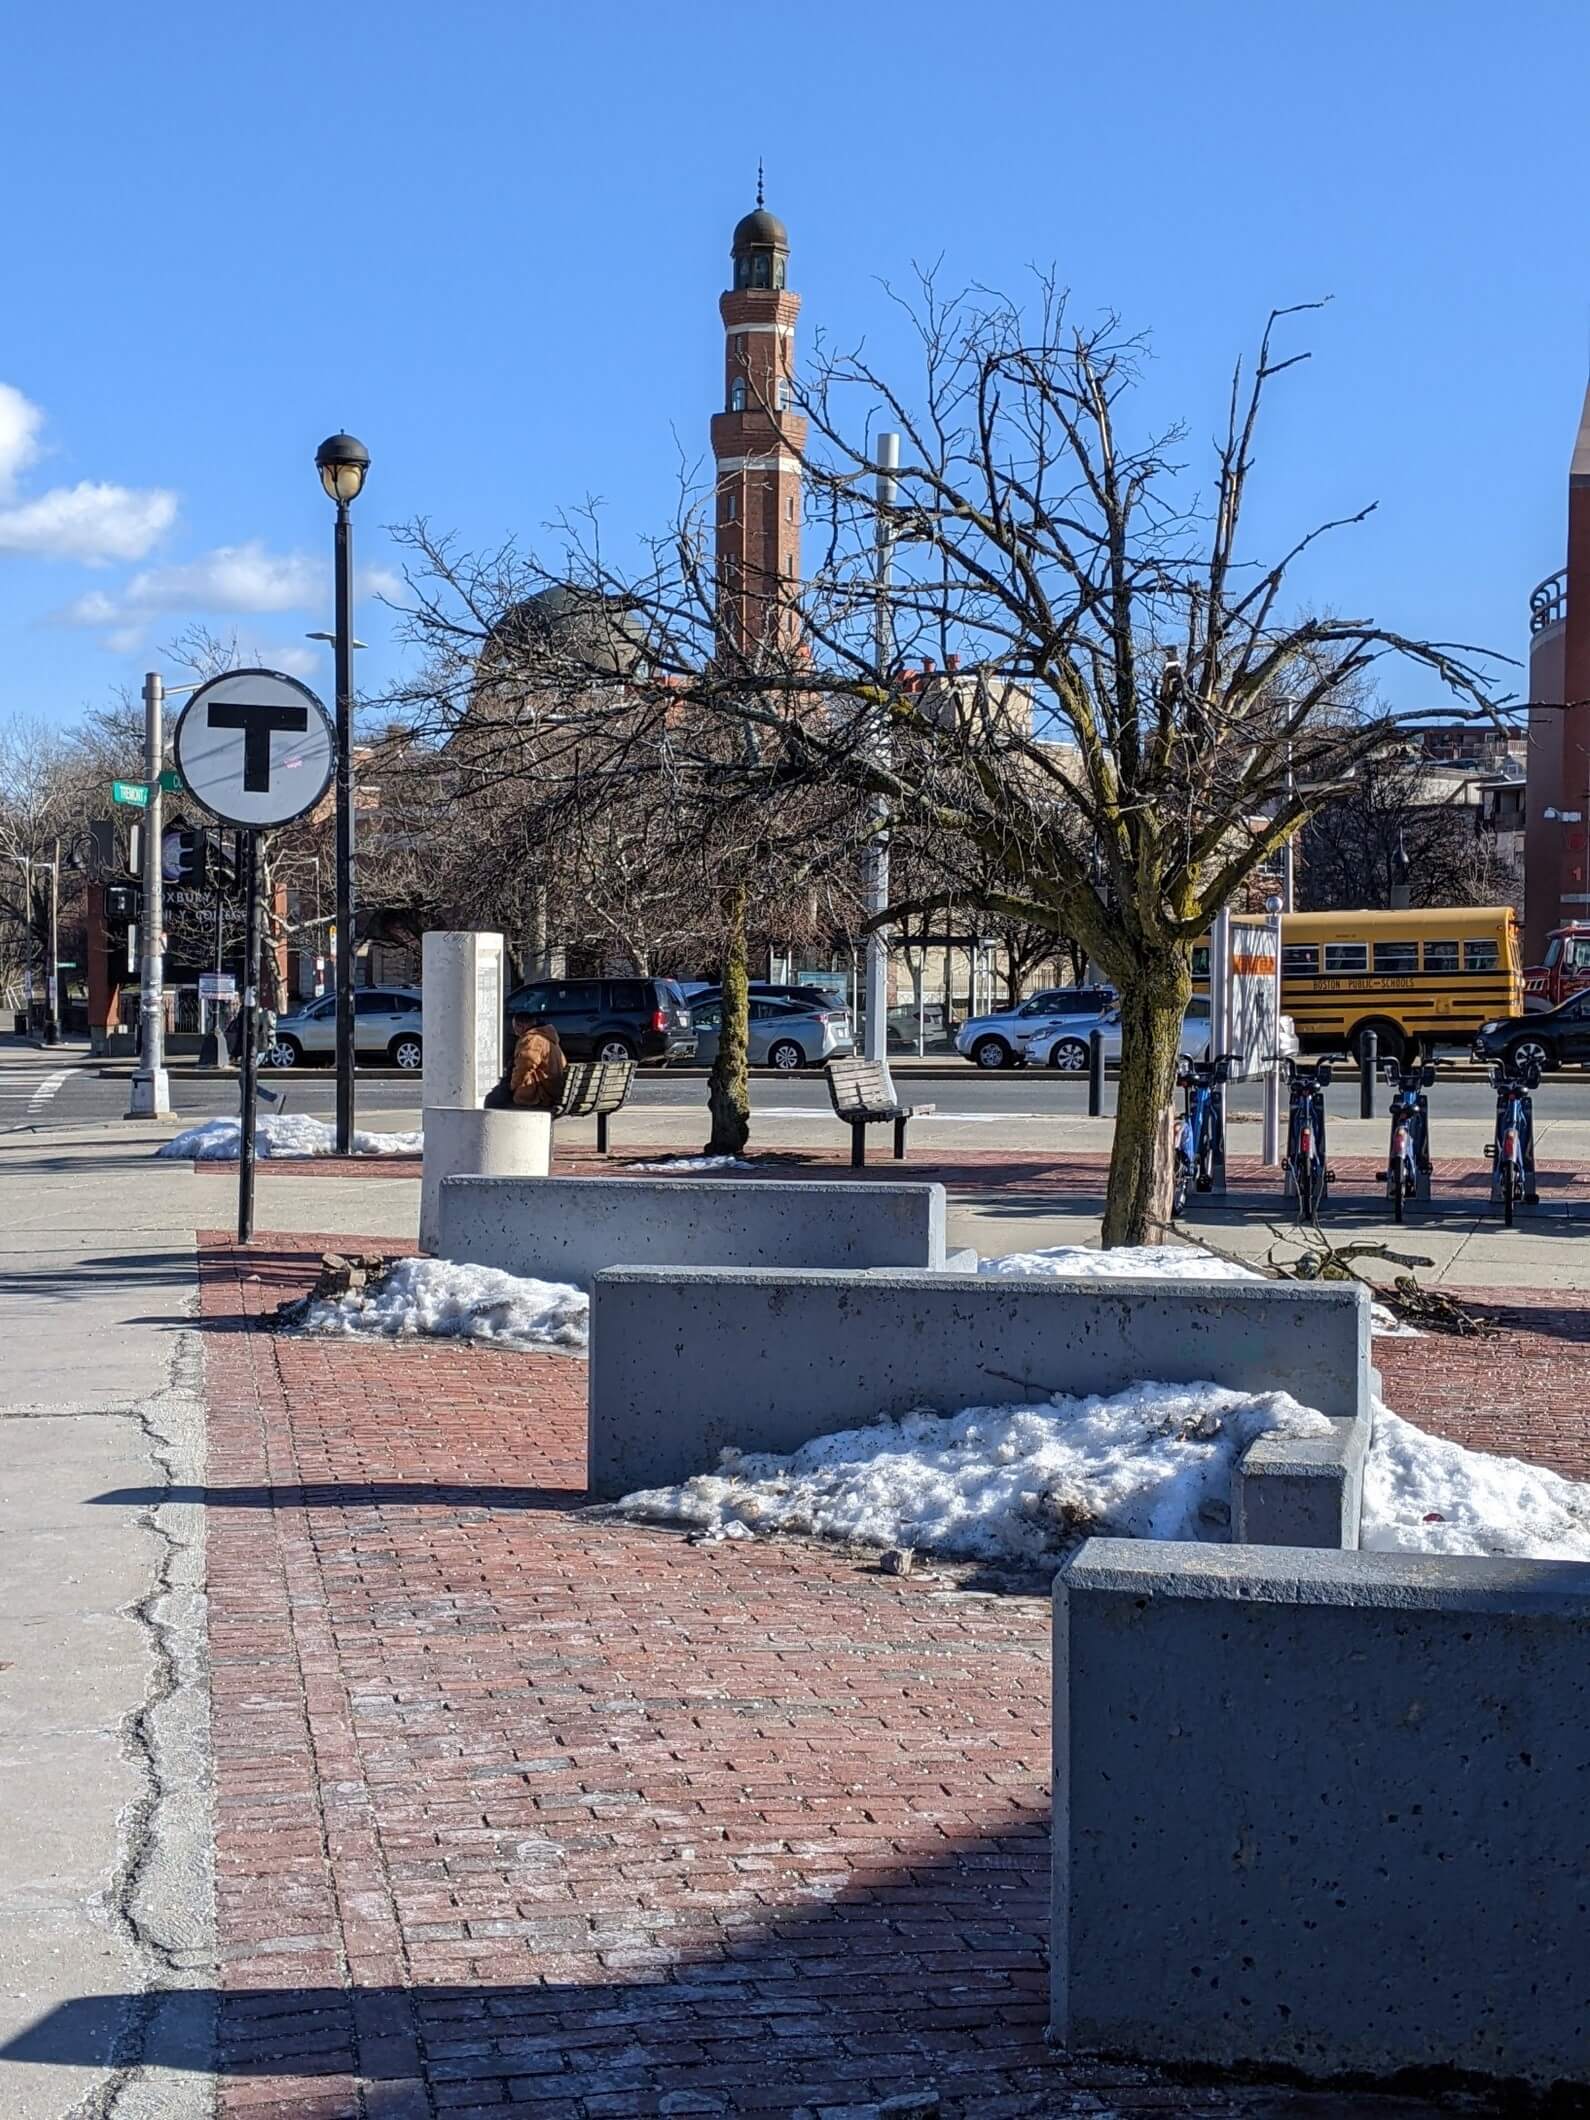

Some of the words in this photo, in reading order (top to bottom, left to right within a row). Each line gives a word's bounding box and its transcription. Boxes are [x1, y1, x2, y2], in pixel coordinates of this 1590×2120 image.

[208, 703, 307, 792] T
[1313, 979, 1340, 990] BOSTON
[1348, 978, 1372, 989] PUBLIC
[1381, 978, 1414, 988] SCHOOLS
